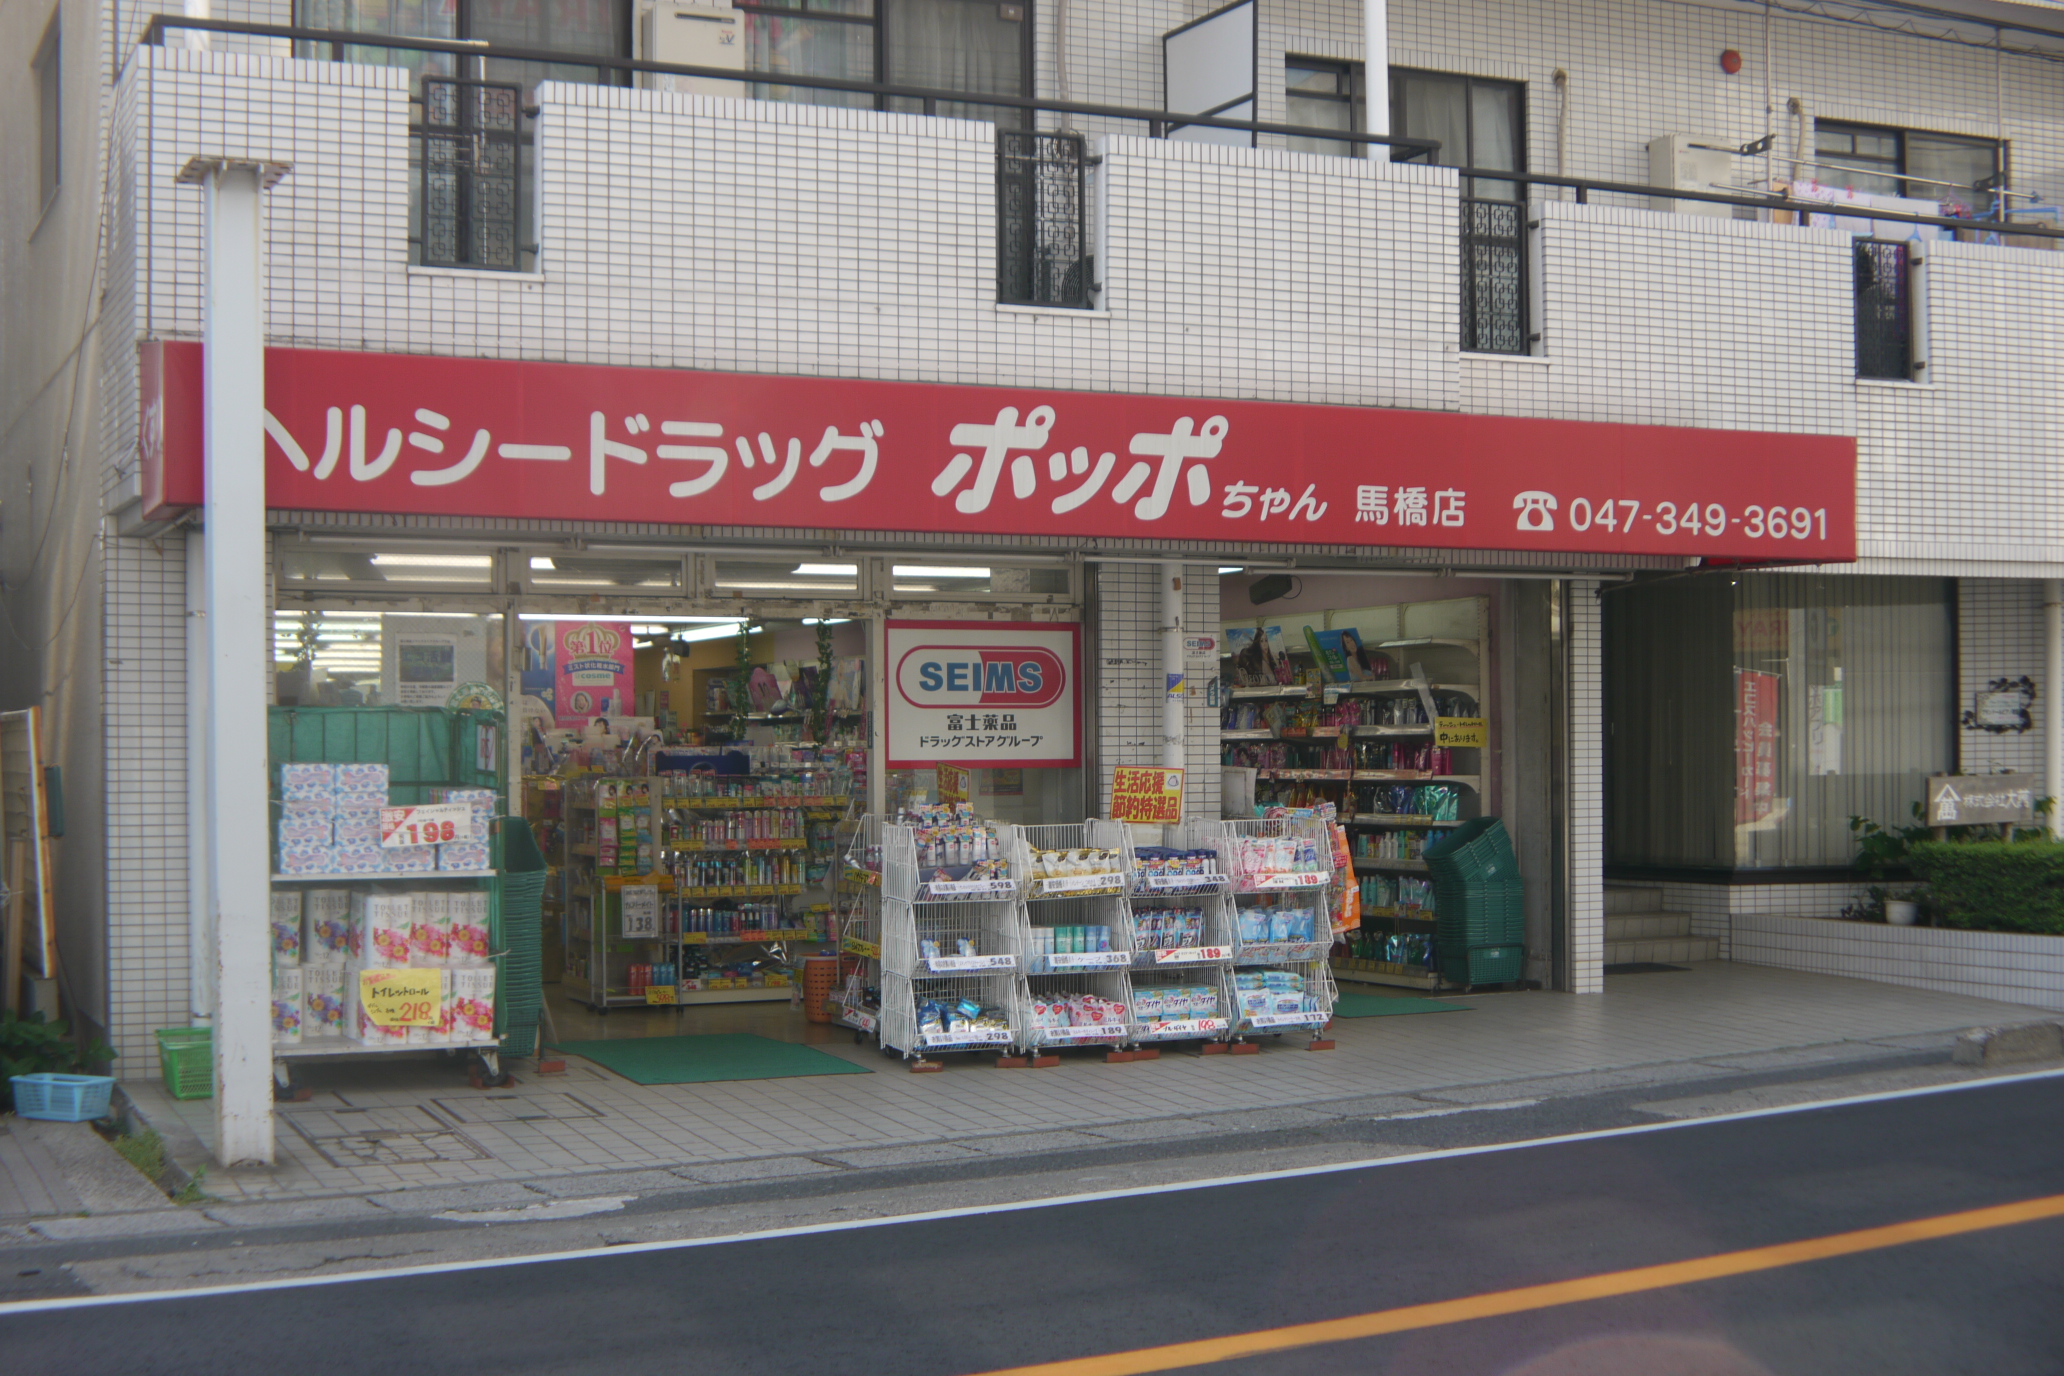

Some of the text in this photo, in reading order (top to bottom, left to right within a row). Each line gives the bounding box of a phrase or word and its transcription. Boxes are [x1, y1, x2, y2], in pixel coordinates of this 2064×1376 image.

[1355, 484, 1466, 527] 馬橋店
[1569, 497, 1827, 540] 047-349-3691
[570, 630, 613, 654] 第1位
[918, 661, 1043, 693] SEIMS
[947, 714, 1017, 731] 富士薬品
[920, 735, 1043, 748] ドラッグストアグループ
[1113, 769, 1165, 795] 生活応援
[1110, 796, 1179, 822] 節約特選品
[406, 820, 455, 844] 198
[990, 881, 1012, 889] 598
[1100, 875, 1121, 885] 298
[314, 896, 349, 904] TOILET
[627, 917, 653, 932] 138
[1106, 954, 1127, 963] 368
[1200, 948, 1221, 959] 189
[990, 957, 1011, 966] 548
[372, 987, 430, 998] トイレットロール
[399, 1001, 432, 1022] 218
[1304, 1013, 1324, 1022] 172
[987, 1032, 1008, 1041] 298
[1101, 1026, 1122, 1035] 189
